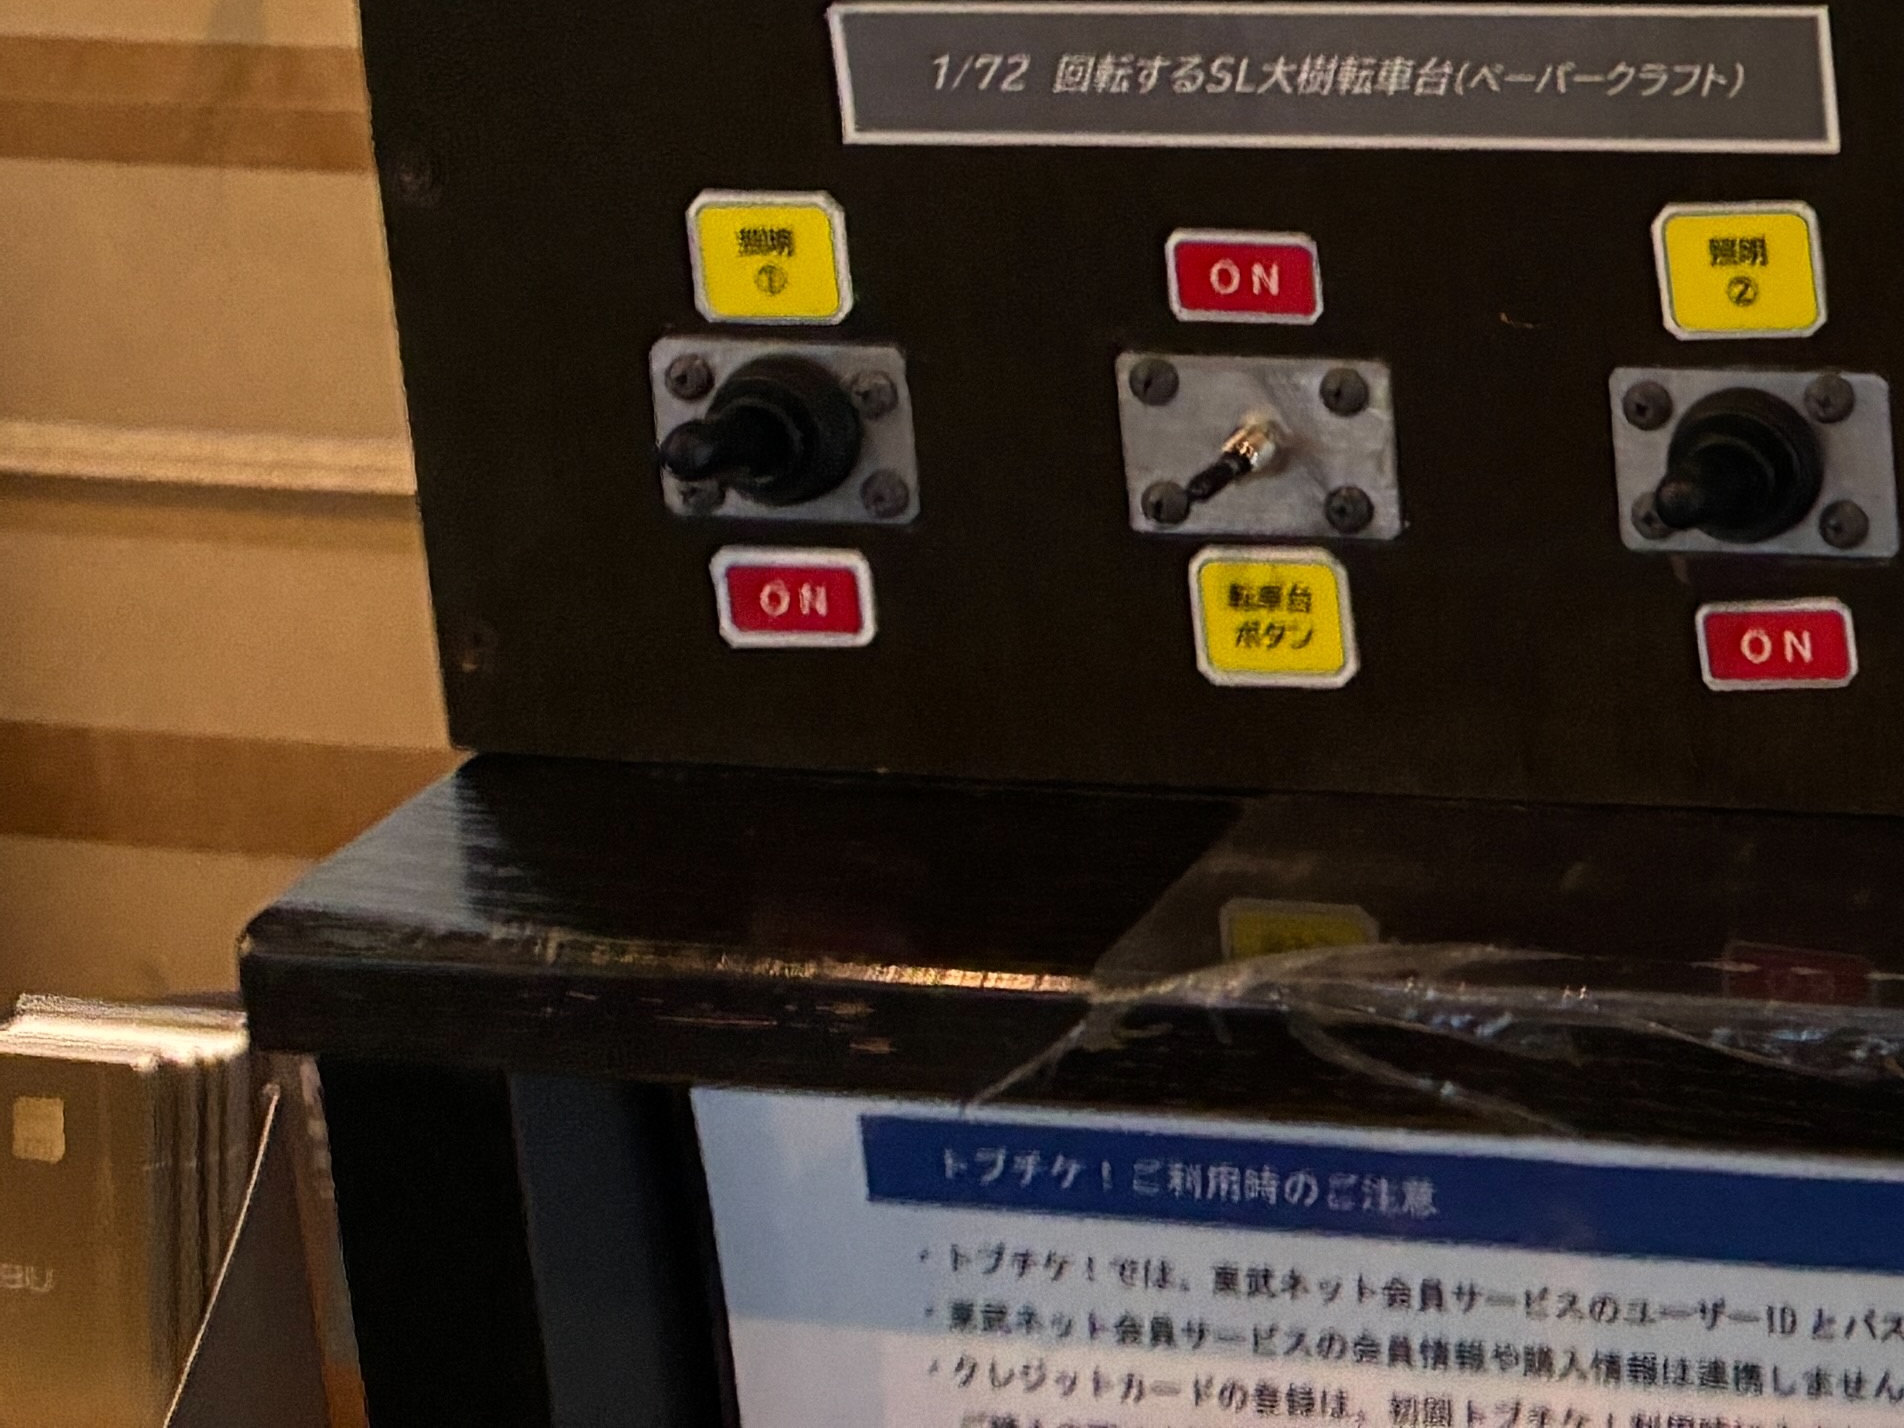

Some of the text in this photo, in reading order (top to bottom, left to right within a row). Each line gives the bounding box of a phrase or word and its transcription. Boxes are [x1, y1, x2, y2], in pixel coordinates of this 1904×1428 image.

[930, 54, 1032, 95] 1/72
[1208, 259, 1281, 296] ON
[758, 579, 828, 618] ON
[1740, 628, 1813, 664] ON
[941, 1148, 1438, 1218] トブチケ！ご利用時のご注意
